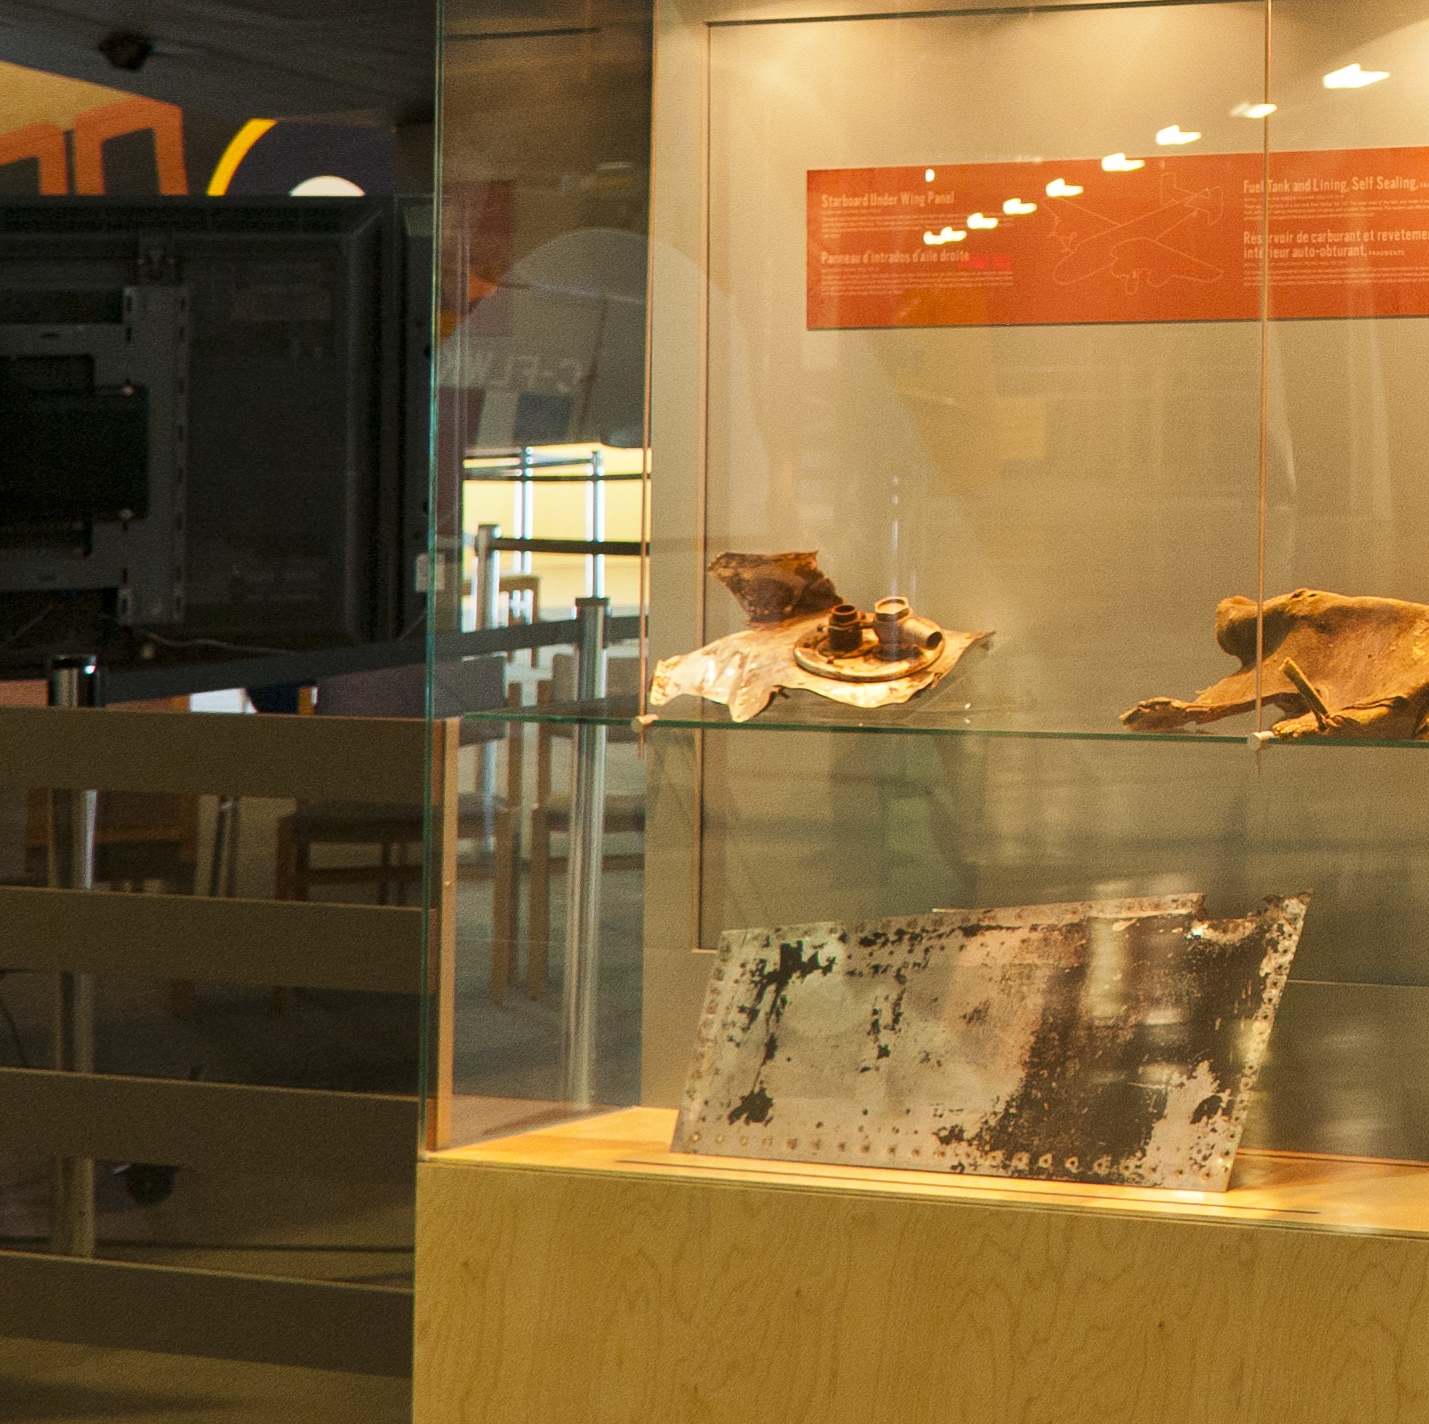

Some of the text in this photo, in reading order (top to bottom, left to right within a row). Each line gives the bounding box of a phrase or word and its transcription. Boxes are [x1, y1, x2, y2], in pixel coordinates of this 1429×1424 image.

[1243, 179, 1265, 194] Fuel
[1267, 179, 1290, 193] Tank
[1292, 178, 1311, 192] and
[1312, 178, 1350, 194] Lining,
[1351, 176, 1374, 191] Self
[1376, 176, 1419, 192] Sealing,
[821, 191, 954, 207] Starboard Under Wing Panel
[1296, 230, 1309, 244] de
[1311, 229, 1361, 243] carburant
[1362, 229, 1375, 243] et
[821, 251, 861, 264] Panneau
[912, 249, 938, 262] d'aile
[940, 249, 970, 261] droite
[1291, 244, 1368, 258] auto-obturant,
